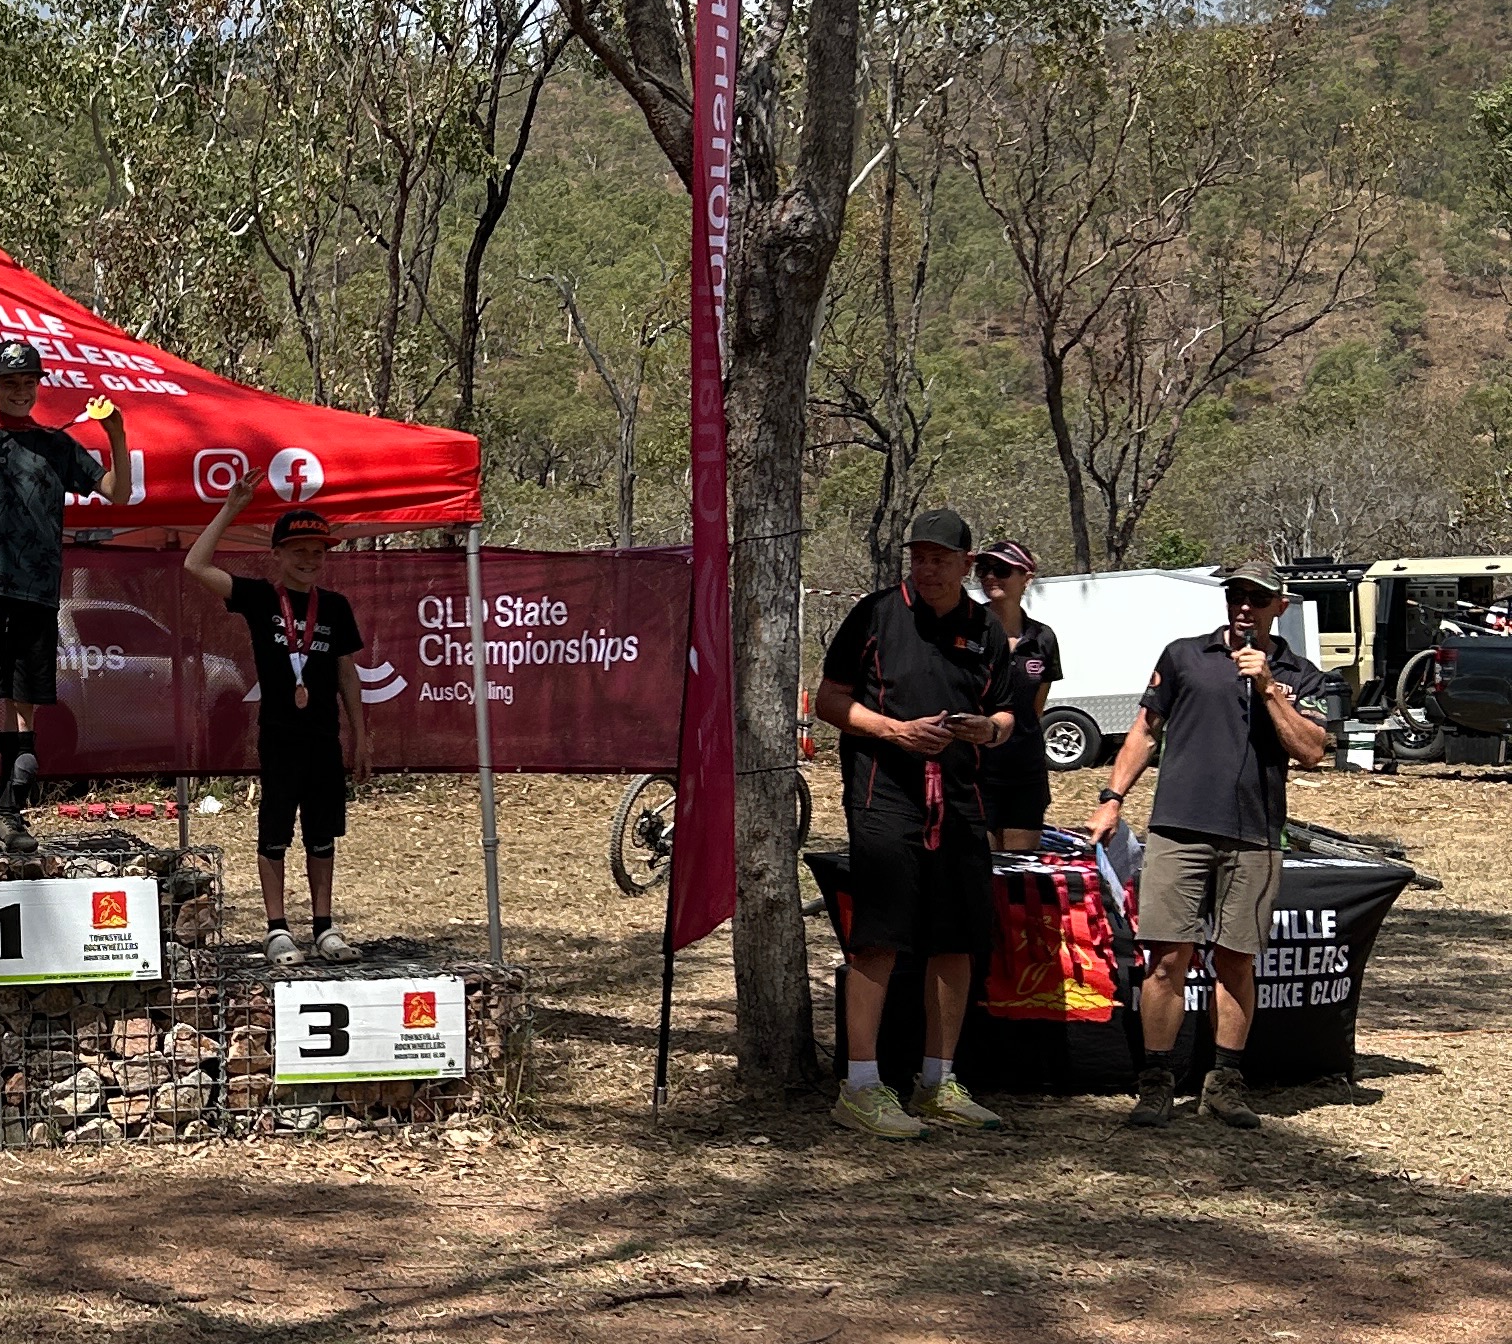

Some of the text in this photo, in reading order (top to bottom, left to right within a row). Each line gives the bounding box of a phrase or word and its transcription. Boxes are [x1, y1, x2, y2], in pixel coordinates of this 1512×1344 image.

[100, 373, 189, 396] CLUB
[494, 594, 568, 628] State
[418, 628, 639, 674] Championships
[418, 681, 514, 705] AusCyling
[1257, 976, 1352, 1009] BIKE CLUB
[299, 1002, 350, 1058] 3
